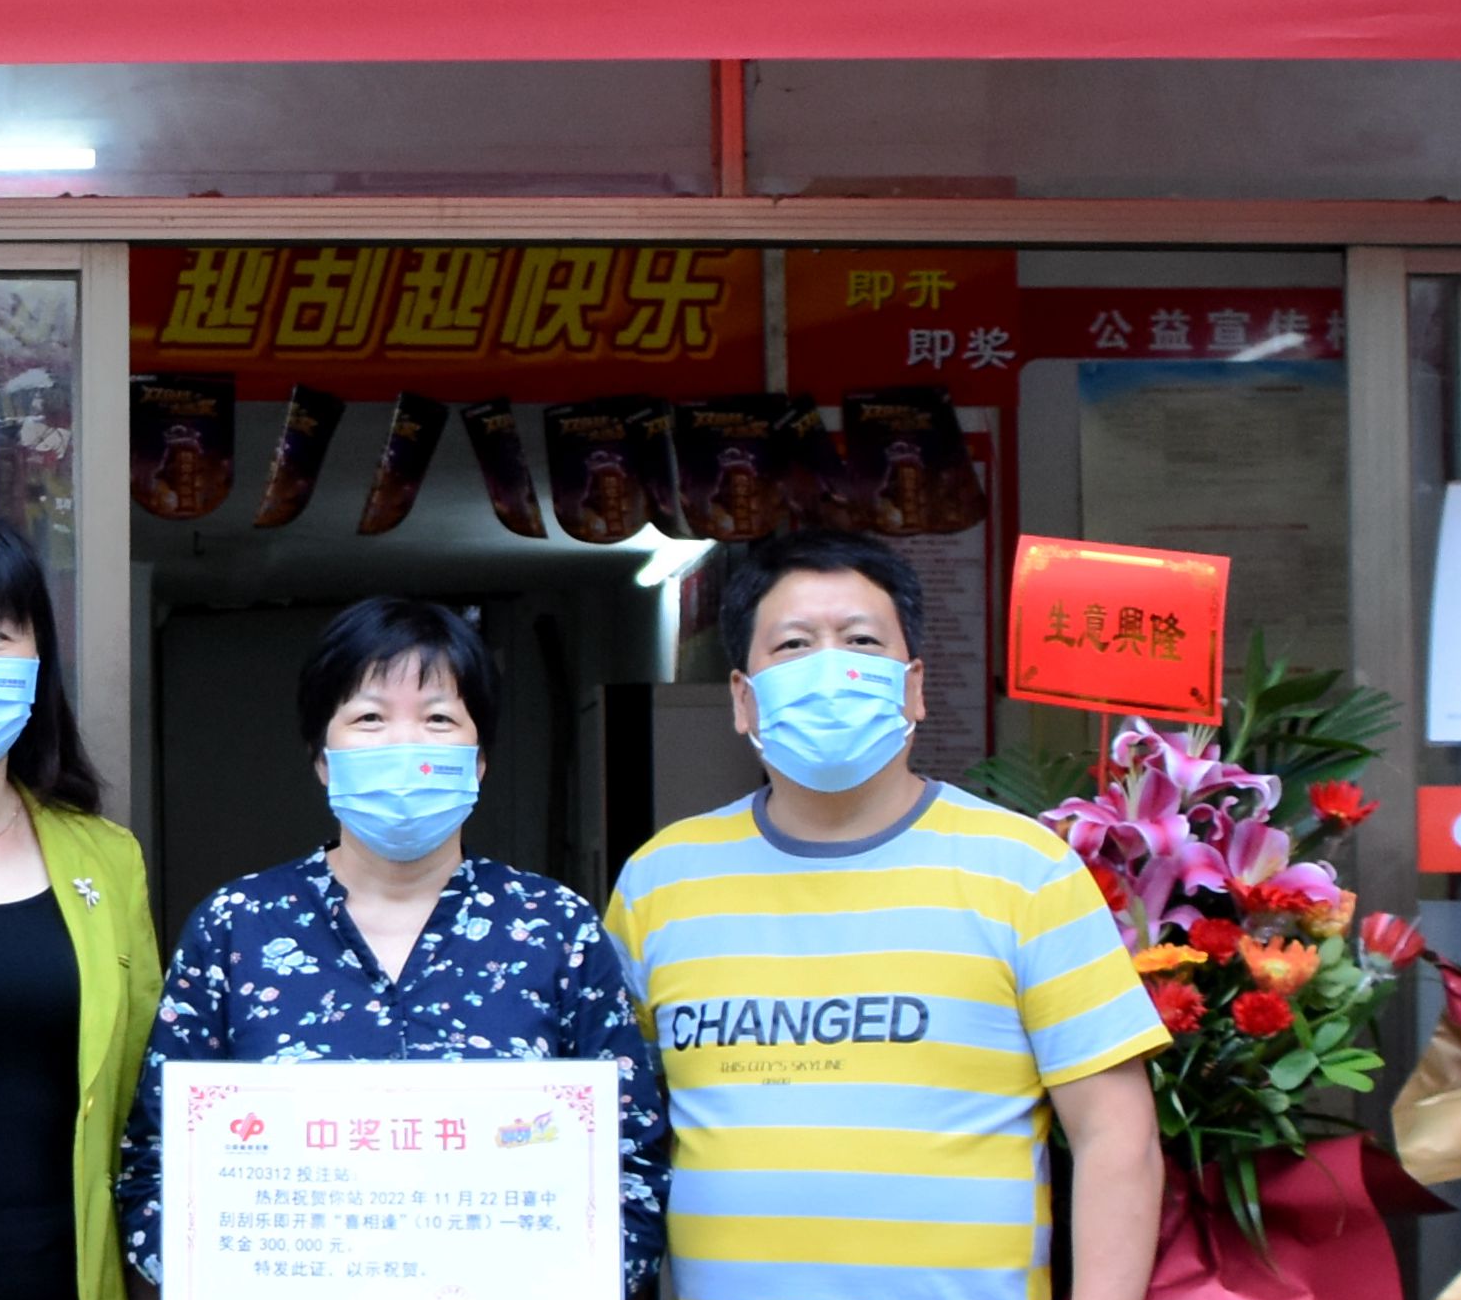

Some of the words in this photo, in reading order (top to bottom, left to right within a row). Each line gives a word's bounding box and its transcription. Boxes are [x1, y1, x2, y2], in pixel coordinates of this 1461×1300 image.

[159, 246, 721, 349] 越刮越快乐
[672, 995, 930, 1052] CHANGED
[305, 1117, 467, 1152] 中奖证书
